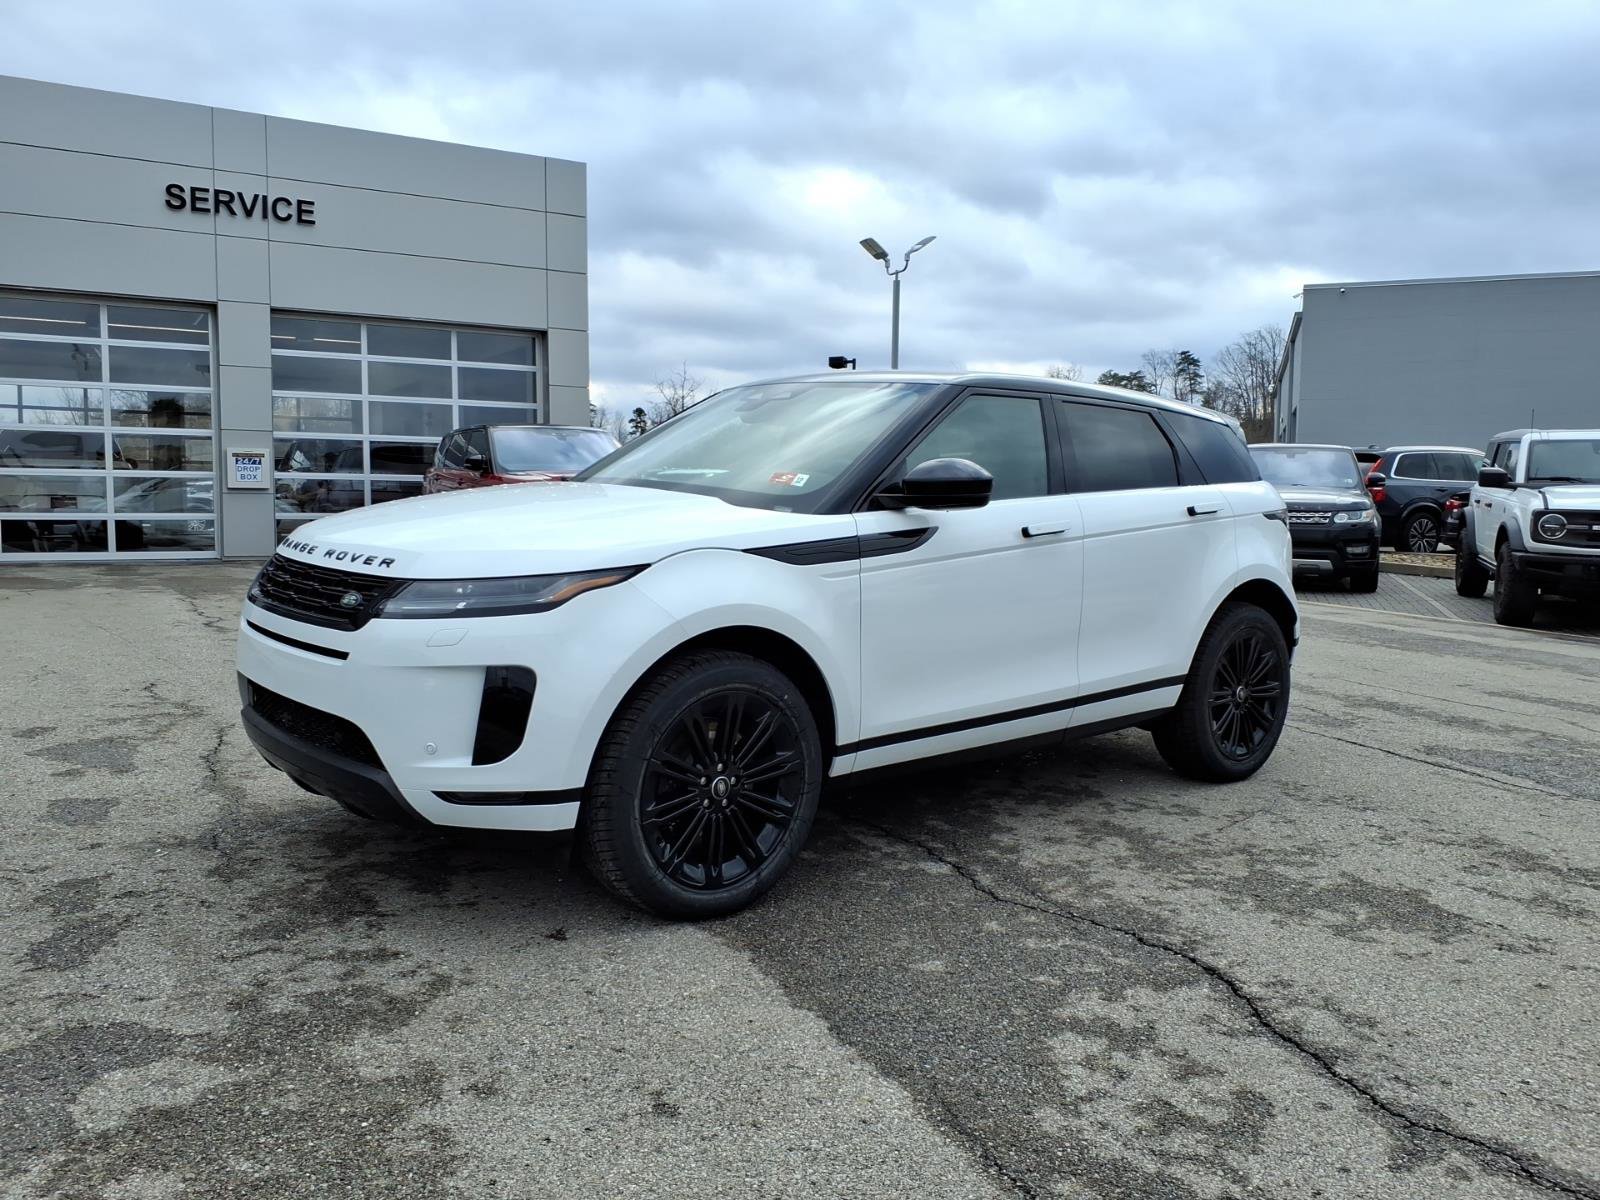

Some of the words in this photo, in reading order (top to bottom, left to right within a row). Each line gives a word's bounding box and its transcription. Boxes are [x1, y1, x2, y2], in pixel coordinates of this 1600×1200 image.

[164, 183, 316, 225] SERVICE
[236, 457, 260, 465] 24/7
[240, 473, 258, 481] BOX
[282, 538, 319, 555] RANGE
[323, 549, 396, 568] ROVER
